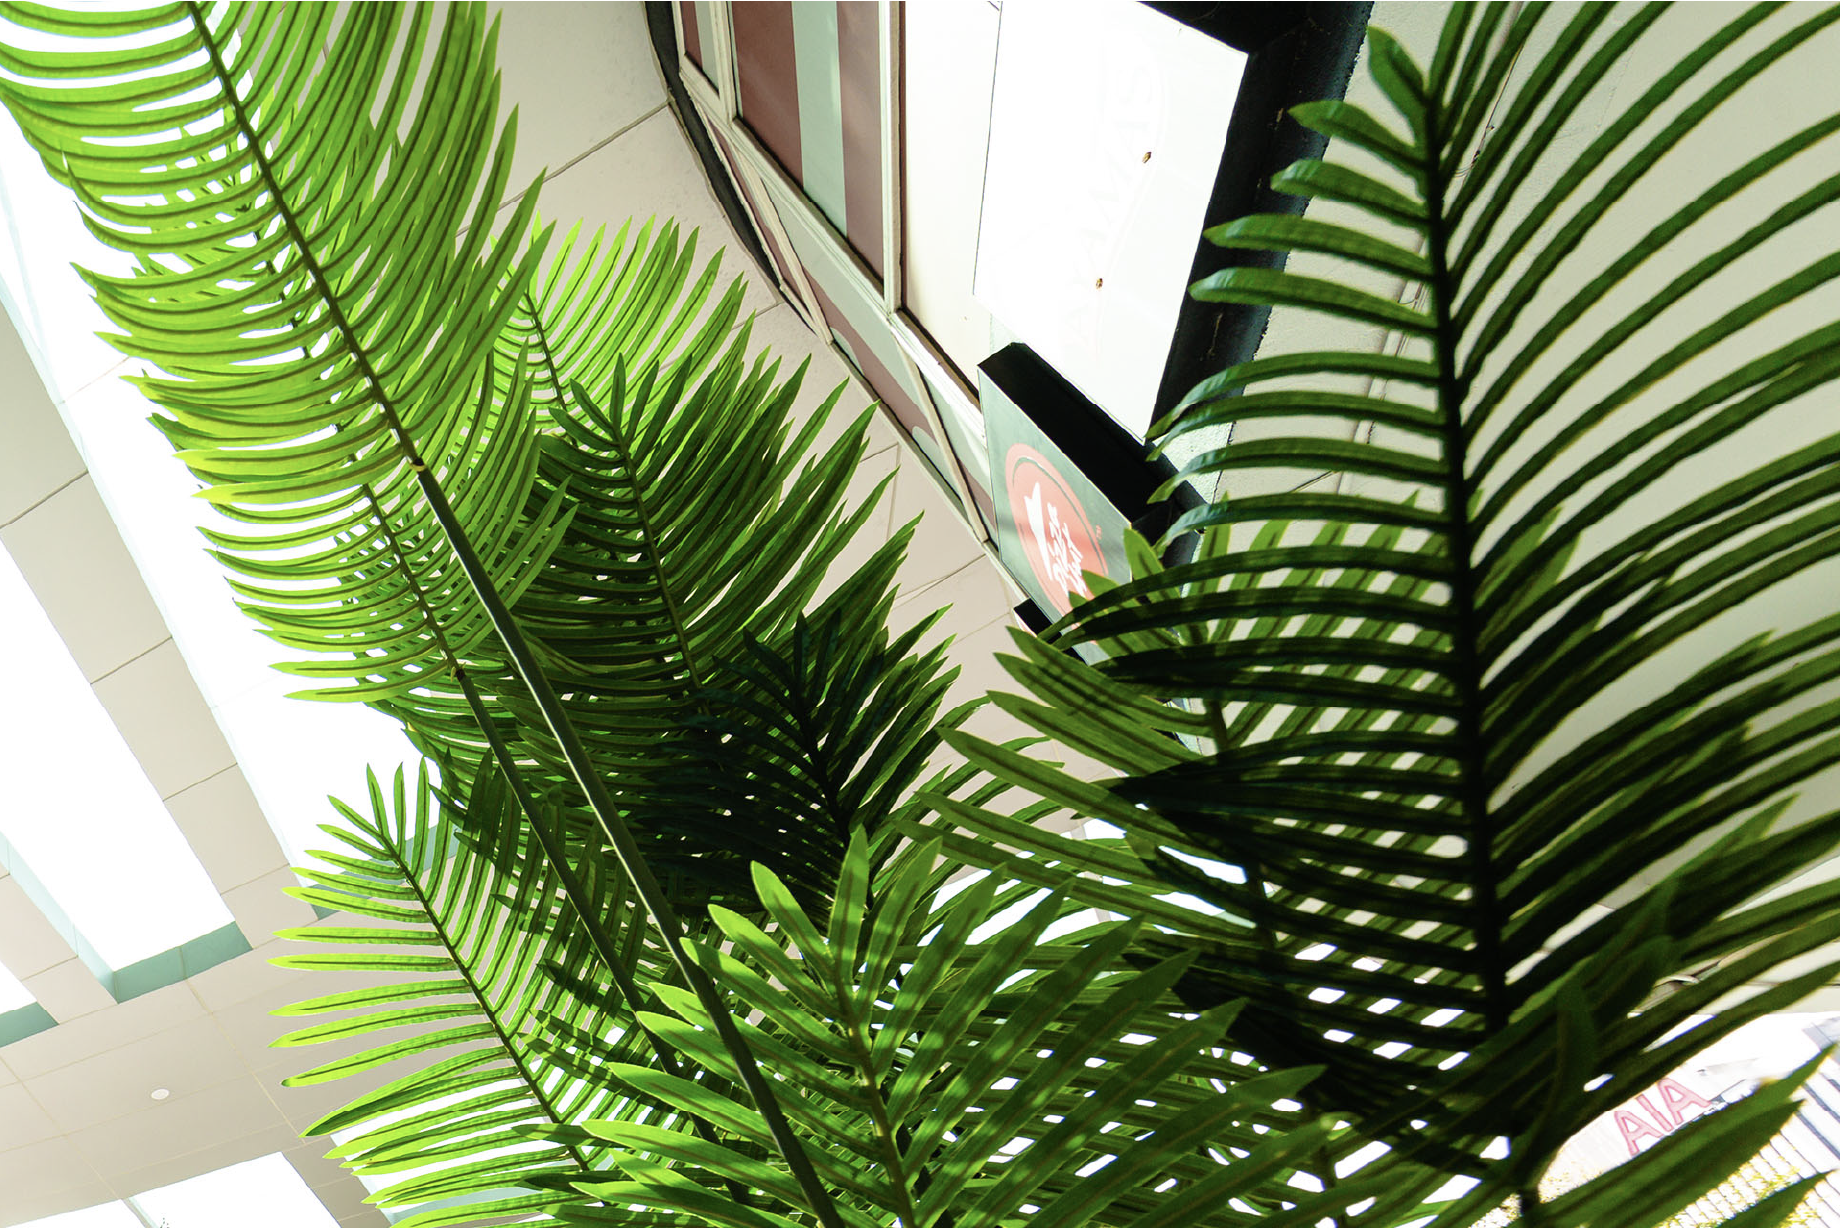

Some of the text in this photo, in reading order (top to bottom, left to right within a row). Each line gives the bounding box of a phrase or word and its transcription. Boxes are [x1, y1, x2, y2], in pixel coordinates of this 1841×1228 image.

[1047, 501, 1069, 598] Pizza
[1062, 522, 1088, 598] Hut
[1613, 1078, 1713, 1157] AIA
